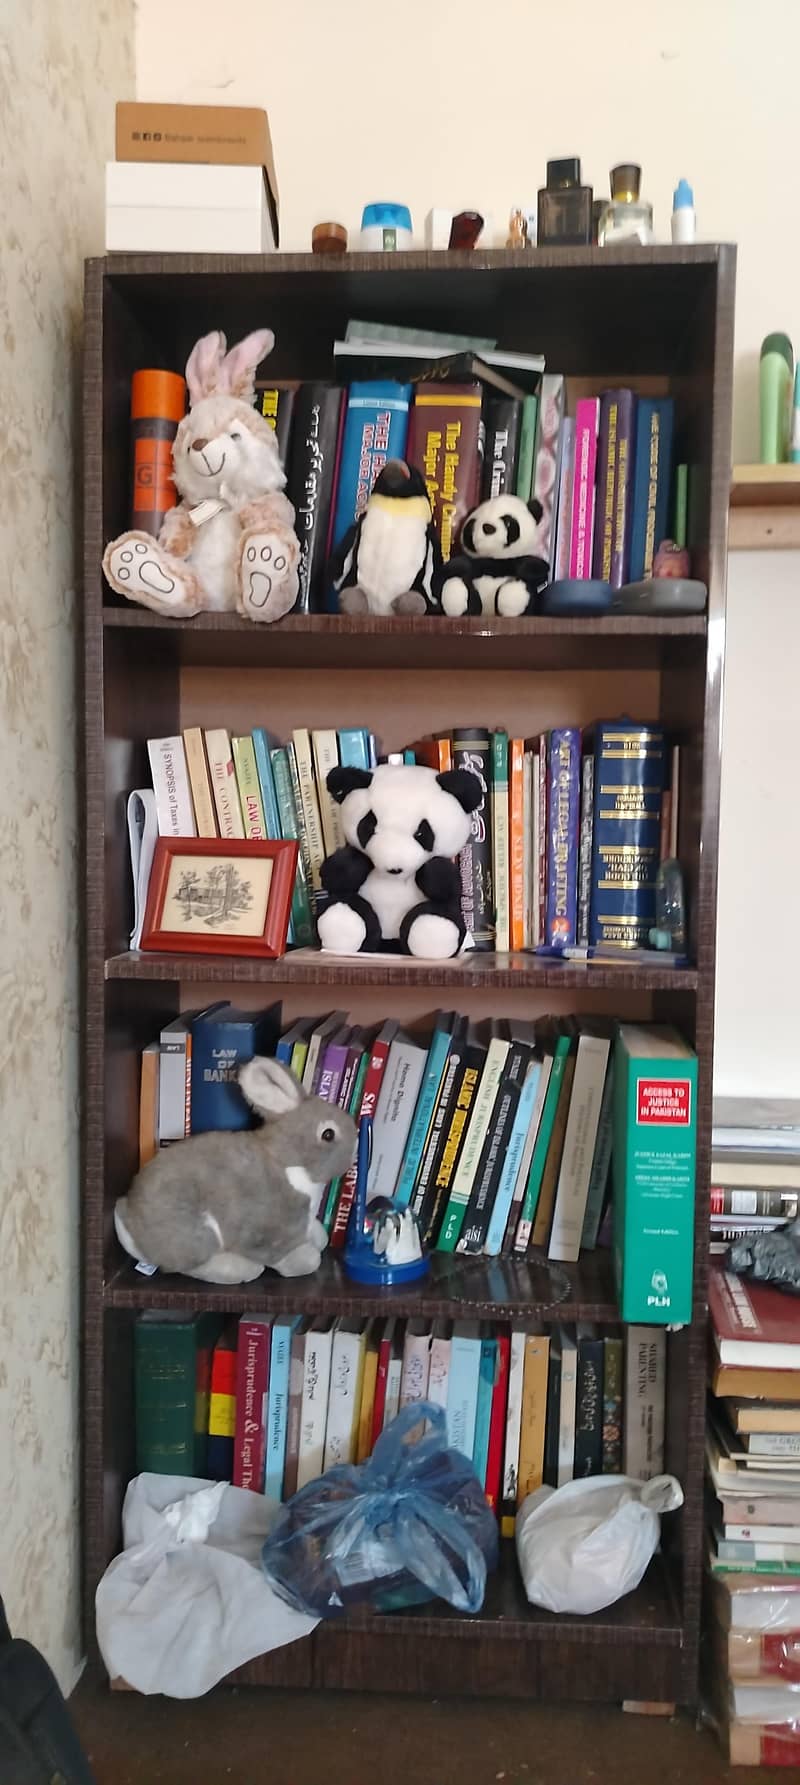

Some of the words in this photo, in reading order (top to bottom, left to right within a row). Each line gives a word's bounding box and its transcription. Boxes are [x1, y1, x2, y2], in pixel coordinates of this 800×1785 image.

[373, 411, 392, 450] THE
[445, 420, 461, 451] The
[423, 431, 442, 478] Major
[440, 453, 461, 502] Handy
[557, 740, 571, 767] ART
[163, 753, 177, 794] SYNOPSIS
[245, 795, 260, 823] LAW
[556, 790, 571, 840] LEGAL
[554, 842, 570, 916] DRAFTING
[211, 1048, 238, 1058] LAW
[217, 1060, 236, 1069] OF
[642, 1086, 673, 1097] ACCESS
[674, 1087, 685, 1098] TO
[647, 1097, 680, 1107] JUSTICE
[640, 1106, 650, 1116] IN
[650, 1107, 687, 1117] PAKISTAN
[504, 1132, 524, 1191] Jurisprudence
[334, 1203, 350, 1233] THE
[464, 1225, 483, 1243] alsi
[245, 1338, 261, 1416] Jurisprudence
[244, 1418, 260, 1434] &
[271, 1392, 285, 1451] Jurisprudence
[240, 1437, 256, 1468] Legal
